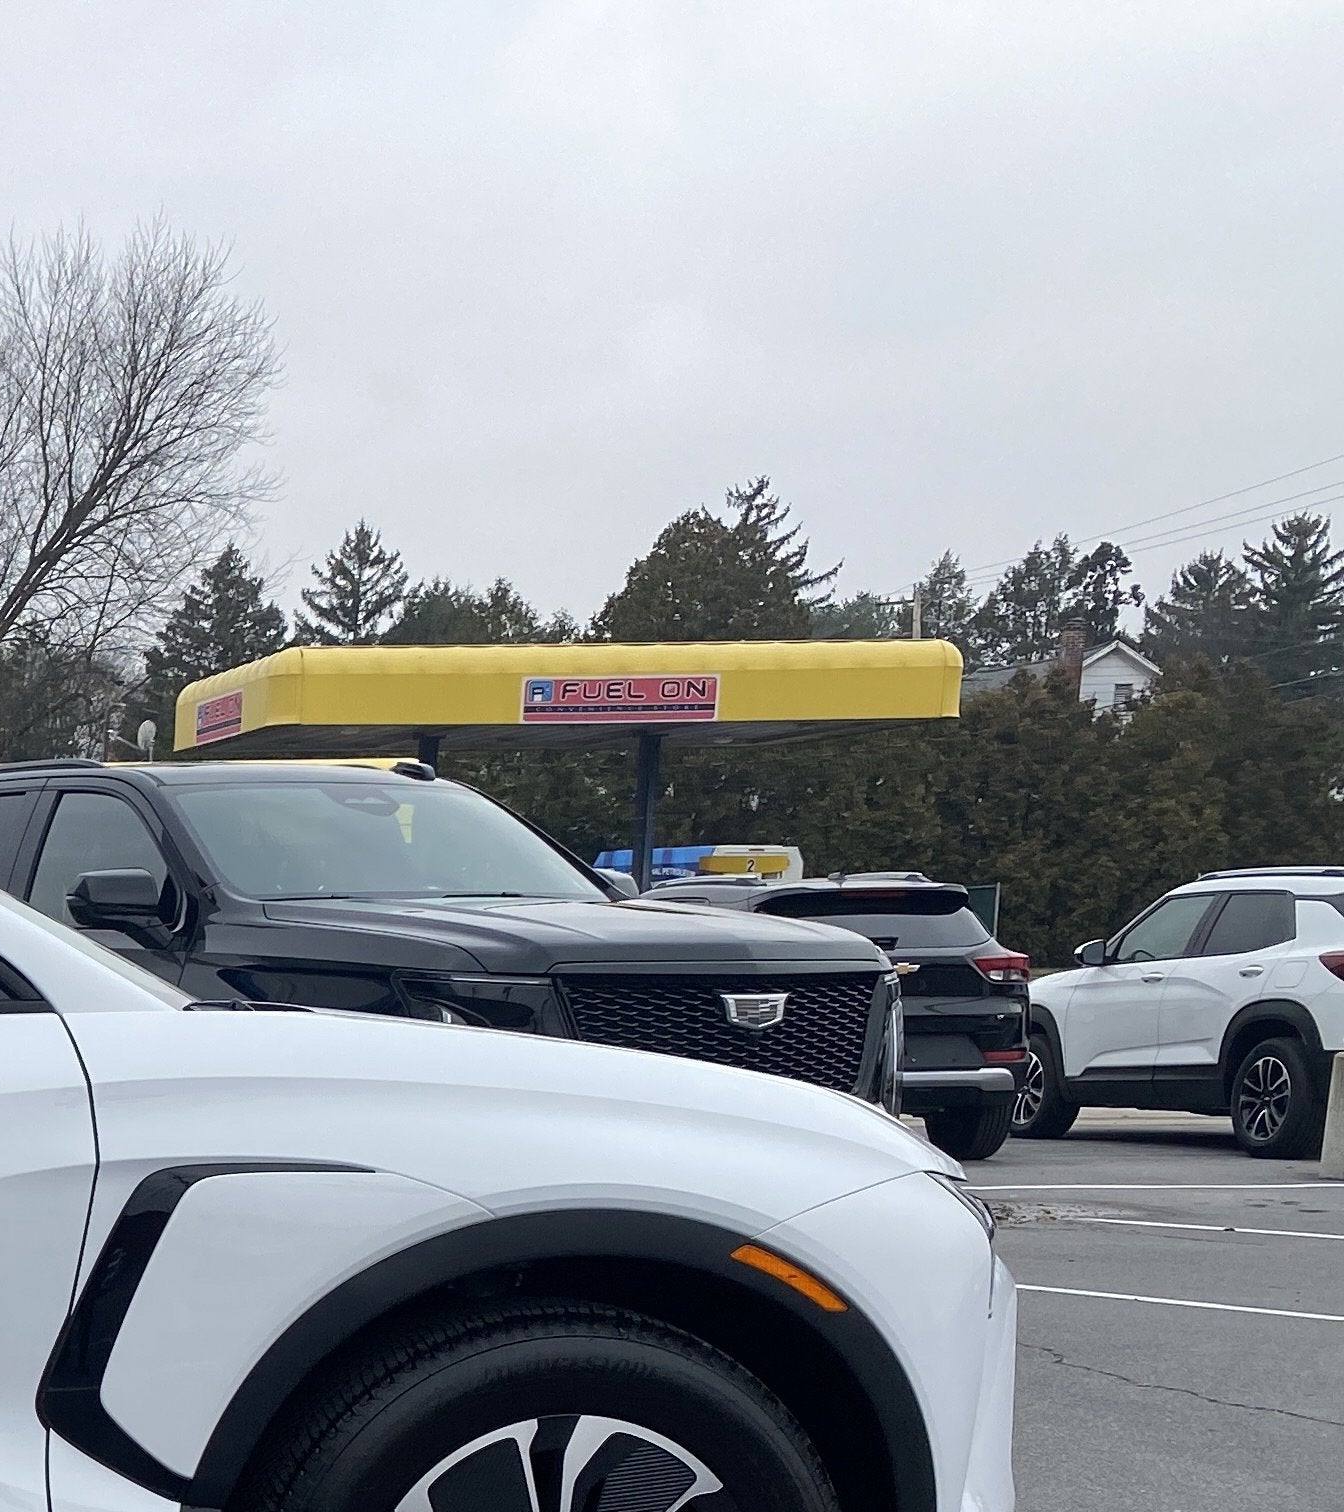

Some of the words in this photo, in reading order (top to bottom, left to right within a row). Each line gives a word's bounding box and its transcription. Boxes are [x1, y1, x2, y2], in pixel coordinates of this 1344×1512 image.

[561, 681, 645, 700] FUEL
[660, 680, 707, 698] ON
[747, 859, 755, 872] 2
